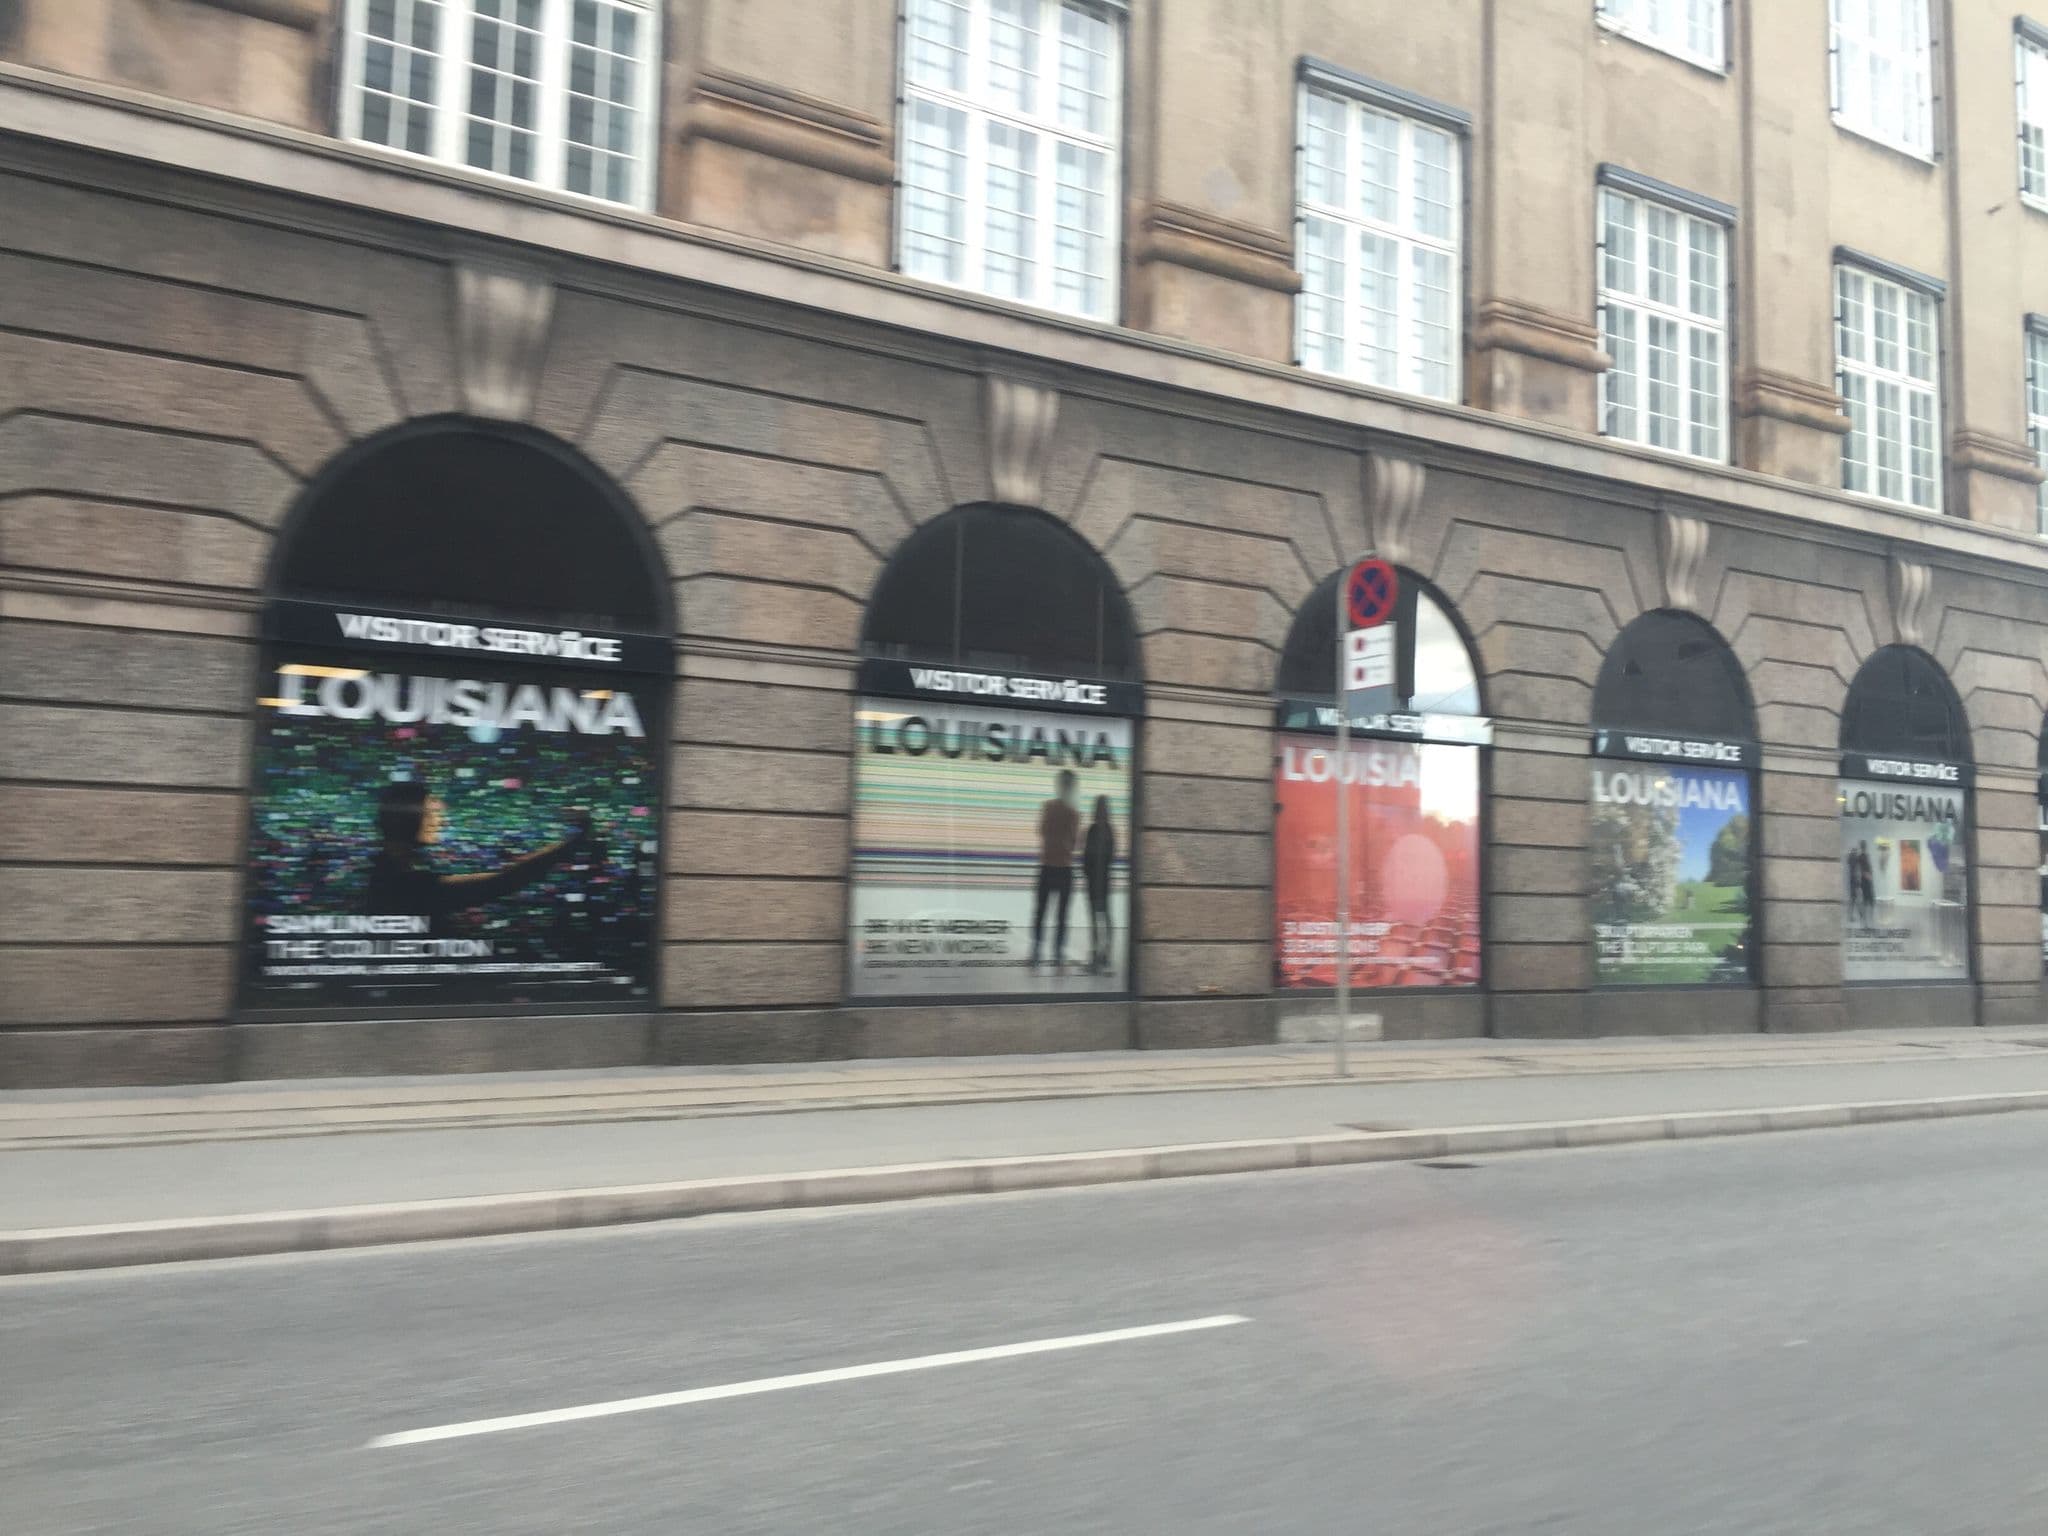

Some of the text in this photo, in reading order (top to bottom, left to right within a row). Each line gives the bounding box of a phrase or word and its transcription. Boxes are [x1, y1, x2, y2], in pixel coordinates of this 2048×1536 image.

[335, 612, 623, 662] VISITOR SERVICE
[277, 669, 647, 738] LOUISIANA
[909, 668, 1108, 705] VISITOR SERVICE
[872, 716, 1117, 770] LOUISIANA
[1625, 736, 1742, 762] VISITOR SERVICE
[1282, 746, 1421, 789] LOUISIA
[1591, 770, 1744, 812] LOUISIANA
[1842, 789, 1959, 824] LOUISIANA
